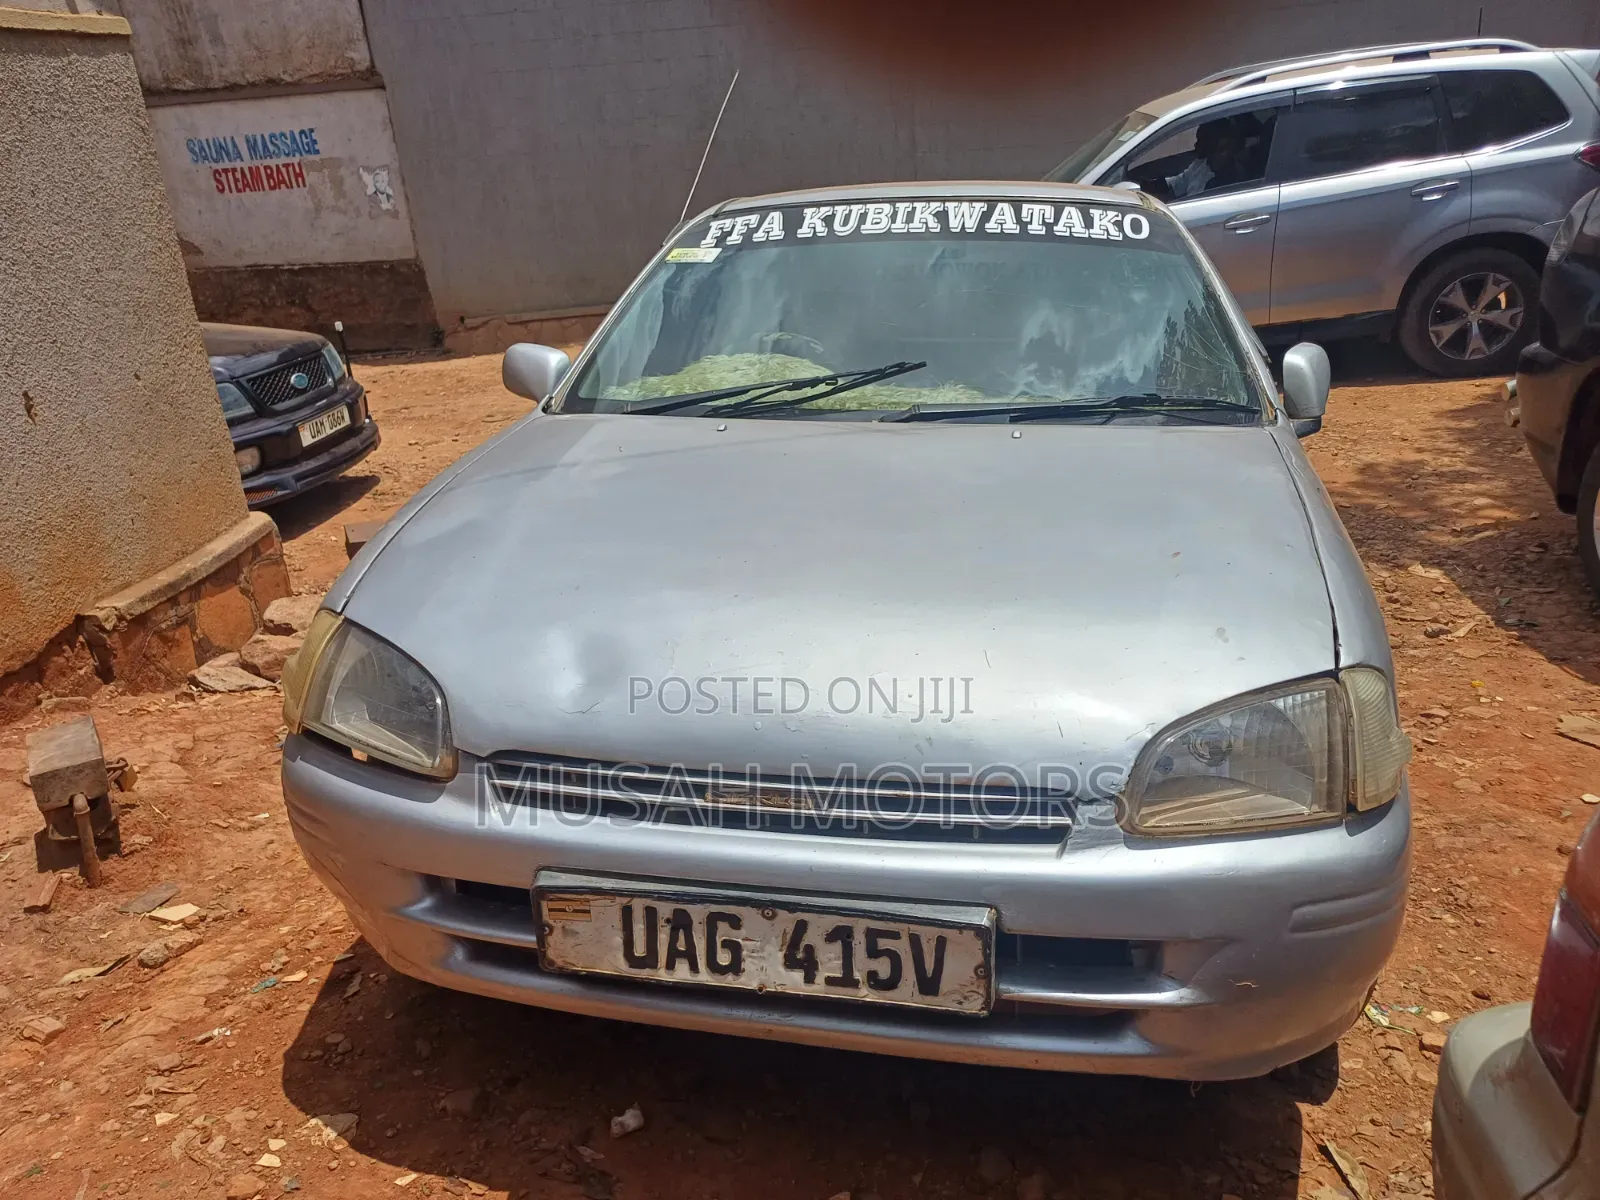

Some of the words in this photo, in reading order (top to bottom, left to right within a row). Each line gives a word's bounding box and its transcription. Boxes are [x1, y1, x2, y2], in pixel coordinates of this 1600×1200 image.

[186, 136, 244, 164] SAUNA
[244, 127, 321, 161] MASSAGE
[212, 166, 264, 195] STEAM
[263, 161, 307, 190] BATH
[700, 211, 785, 248] FFA
[797, 201, 1151, 241] KUBIKWATAKO
[308, 418, 327, 440] UAM
[620, 904, 746, 978] UAG
[782, 918, 948, 997] 415V
